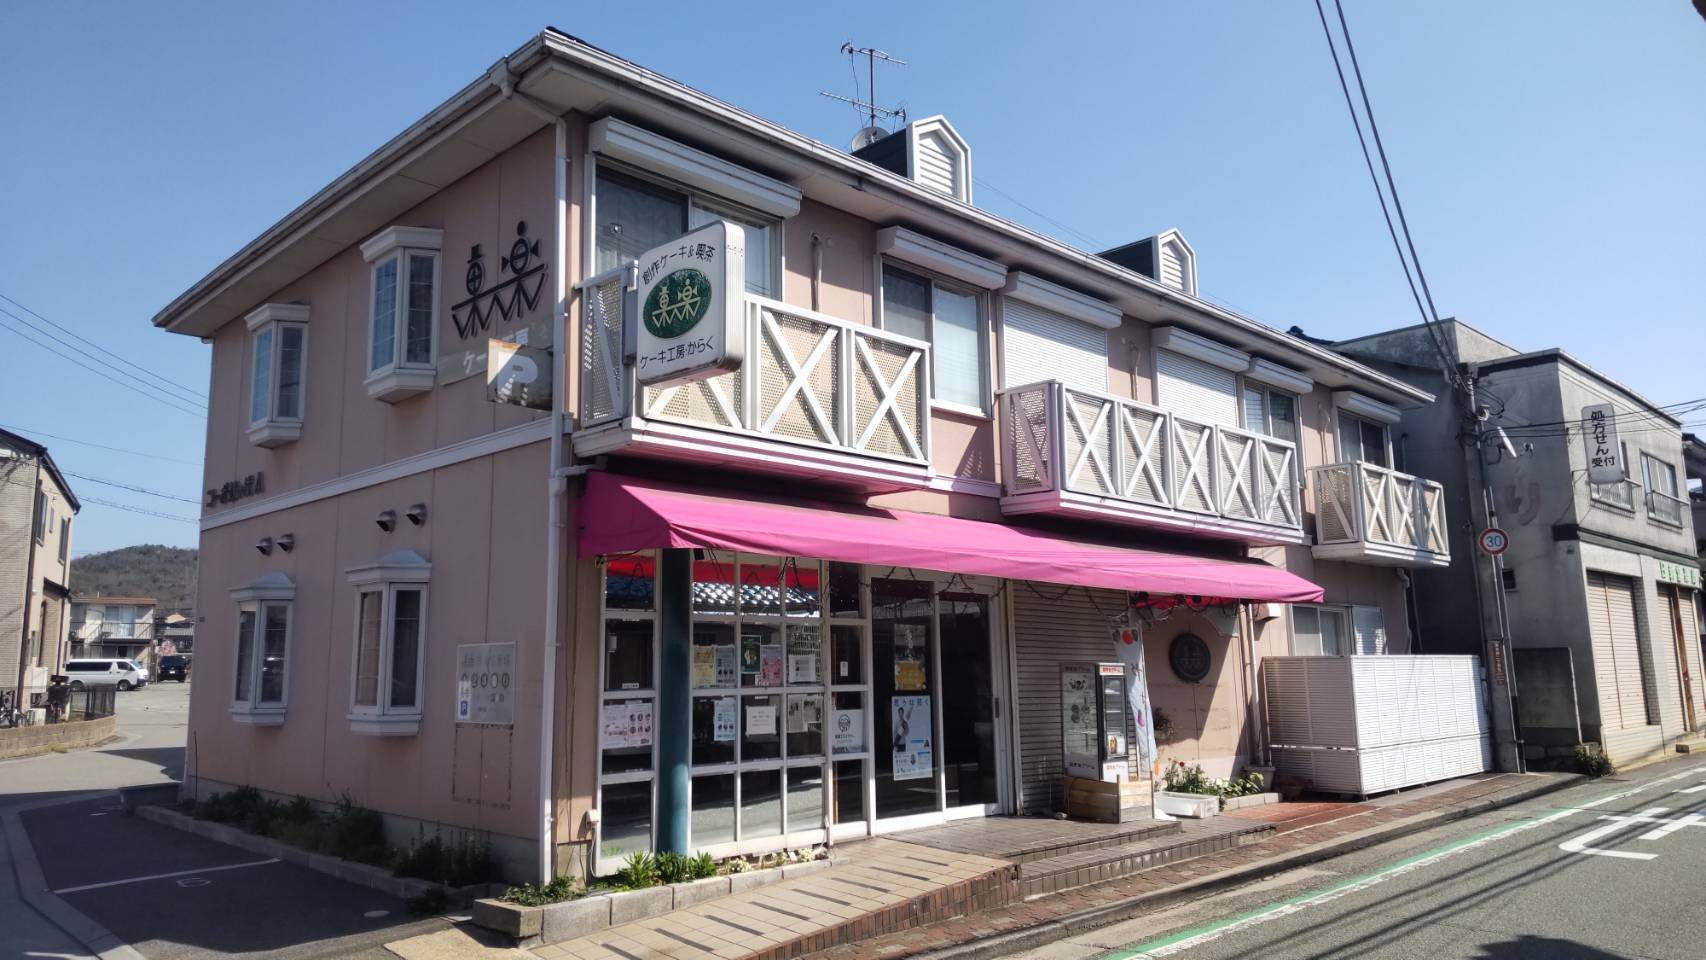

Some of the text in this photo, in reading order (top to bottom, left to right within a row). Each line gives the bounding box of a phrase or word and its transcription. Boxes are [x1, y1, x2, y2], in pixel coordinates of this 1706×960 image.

[1591, 410, 1608, 455] 処方せん
[1592, 456, 1615, 468] 受付
[1486, 535, 1502, 547] 30
